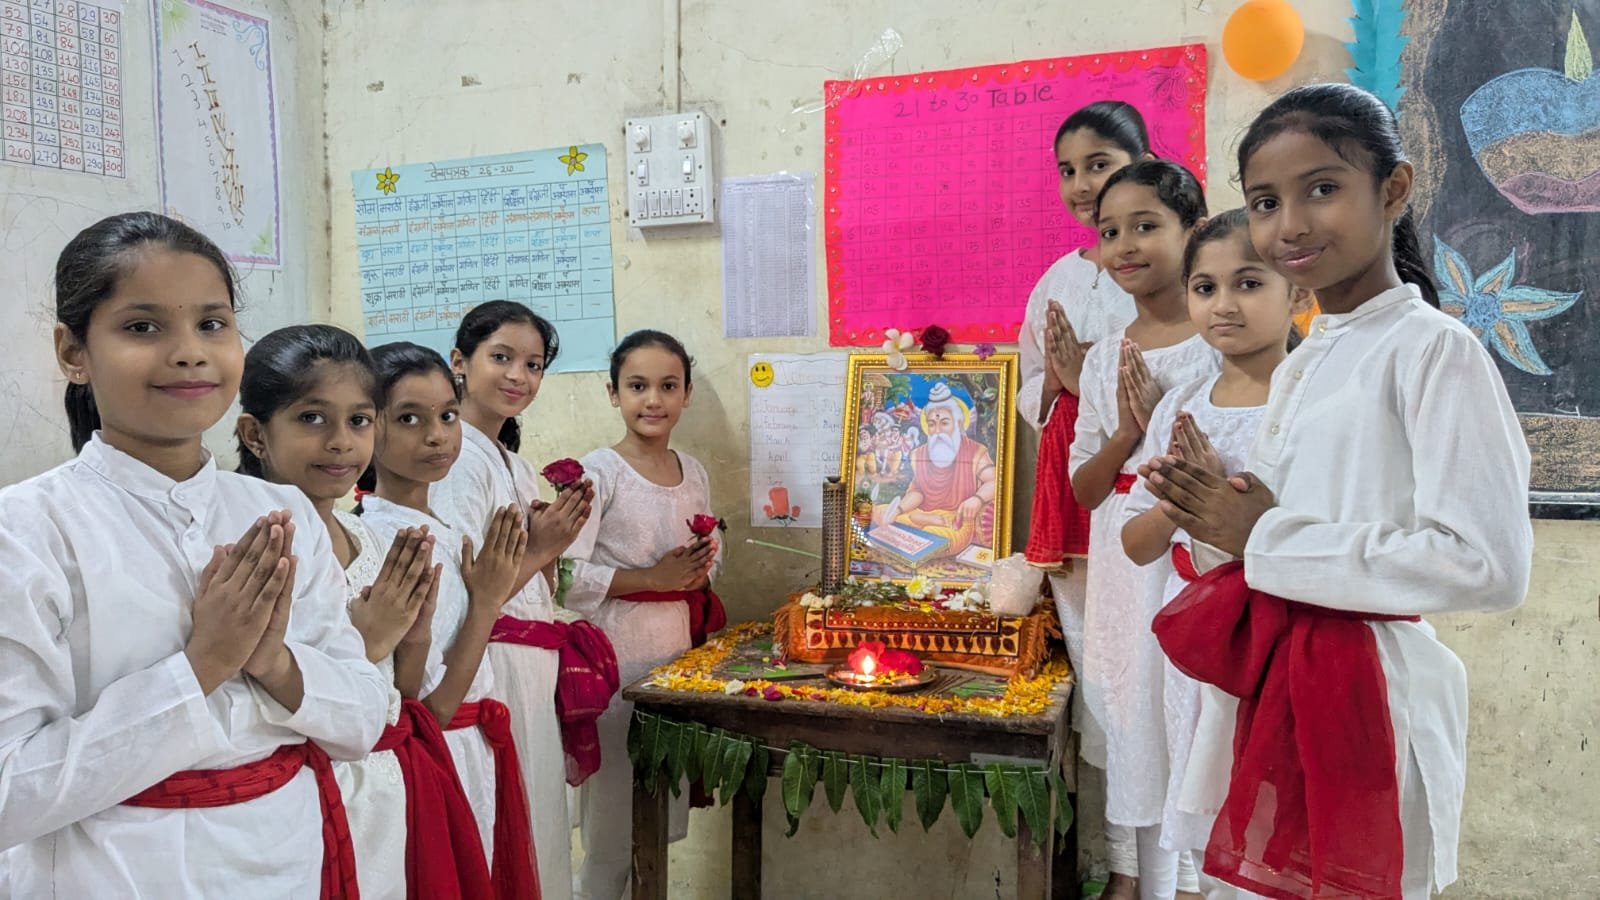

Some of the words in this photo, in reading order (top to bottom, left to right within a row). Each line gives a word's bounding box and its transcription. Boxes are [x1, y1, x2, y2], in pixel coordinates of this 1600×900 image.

[5, 6, 24, 20] 52
[34, 13, 49, 27] 54
[59, 22, 73, 34] 56
[81, 29, 95, 40] 58
[58, 3, 75, 17] 28
[80, 7, 96, 21] 29
[103, 11, 118, 24] 30
[4, 22, 23, 37] 78
[36, 30, 50, 44] 81
[60, 37, 74, 49] 84
[105, 50, 116, 60] 90
[3, 39, 29, 56] 104
[34, 48, 53, 62] 108
[59, 54, 79, 66] 112
[103, 65, 117, 76] 120
[5, 59, 29, 72] 130
[35, 64, 54, 77] 135
[60, 70, 79, 84] 140
[103, 80, 118, 92] 150
[6, 74, 27, 88] 156
[35, 80, 56, 93] 162
[181, 73, 195, 87] 2
[6, 90, 28, 104] 182
[84, 106, 101, 117] 203
[191, 89, 201, 110] 3
[895, 99, 920, 119] 21
[930, 94, 948, 112] to
[955, 91, 979, 112] 30
[987, 84, 1055, 109] Table
[6, 109, 27, 122] 208
[35, 113, 56, 127] 216
[61, 120, 80, 131] 224
[198, 118, 208, 129] 4
[6, 126, 30, 139] 234
[37, 131, 57, 144] 243
[204, 135, 212, 148] 5
[8, 145, 32, 161] 260
[36, 150, 58, 164] 270
[62, 152, 81, 165] 280
[86, 158, 102, 170] 290
[105, 160, 122, 172] 300
[208, 153, 215, 167] 6
[212, 170, 219, 183] 7
[215, 185, 222, 201] 8
[217, 205, 225, 216] 9
[222, 222, 232, 232] 10
